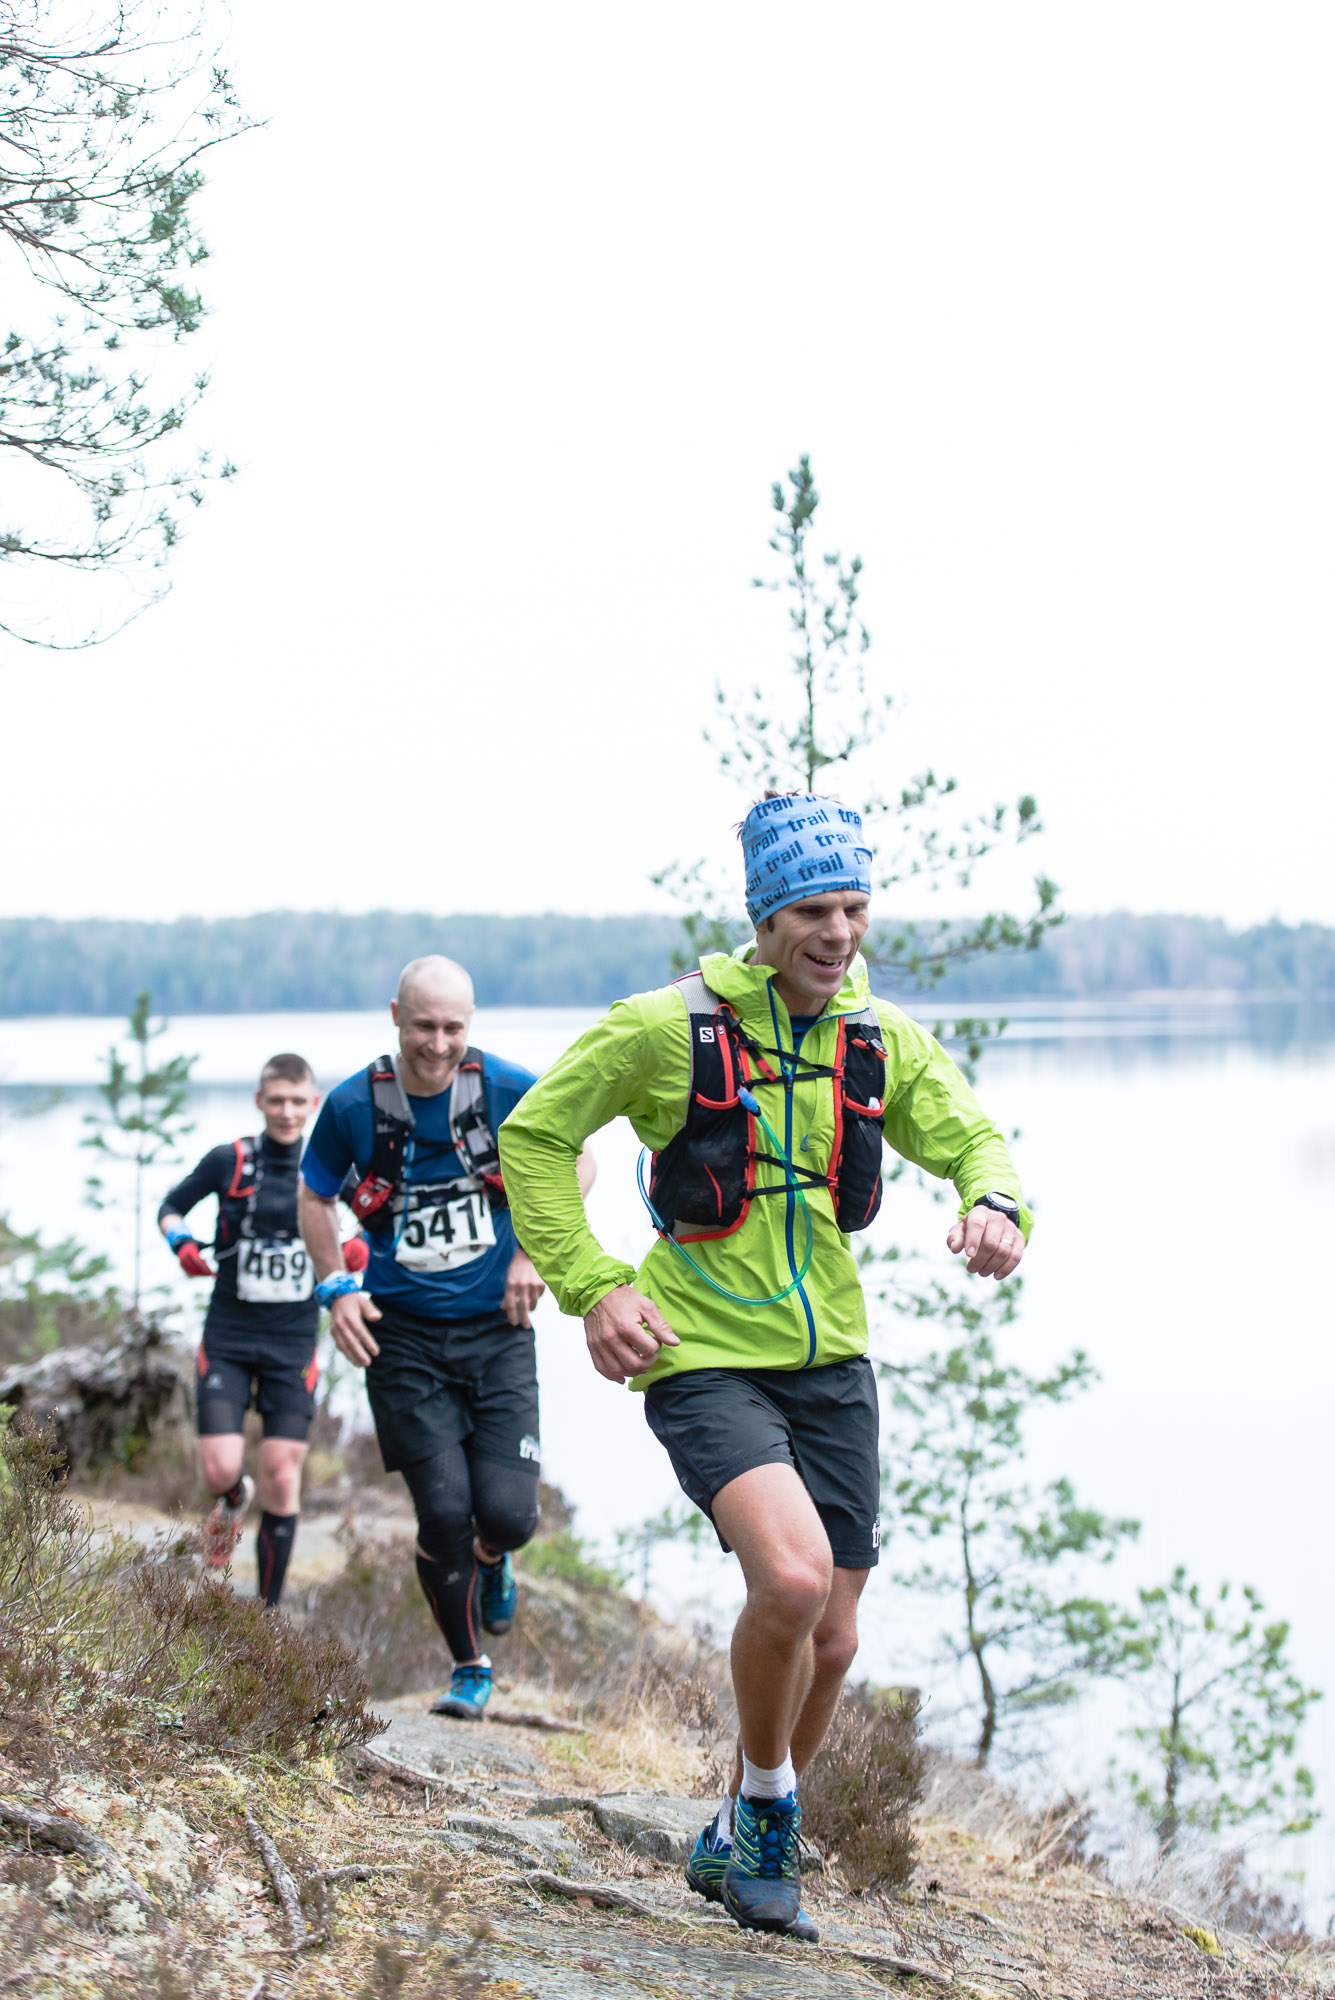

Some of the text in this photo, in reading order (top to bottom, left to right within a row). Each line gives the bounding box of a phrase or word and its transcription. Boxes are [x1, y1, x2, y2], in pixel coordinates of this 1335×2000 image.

[755, 797, 793, 819] trail
[751, 825, 780, 858] trail
[787, 809, 829, 832] trail
[838, 809, 862, 825] tra
[766, 840, 804, 874] trail
[815, 831, 856, 847] trail
[760, 875, 790, 908] trail
[798, 852, 844, 881] trail
[405, 1199, 479, 1249] 541
[245, 1246, 307, 1281] 469
